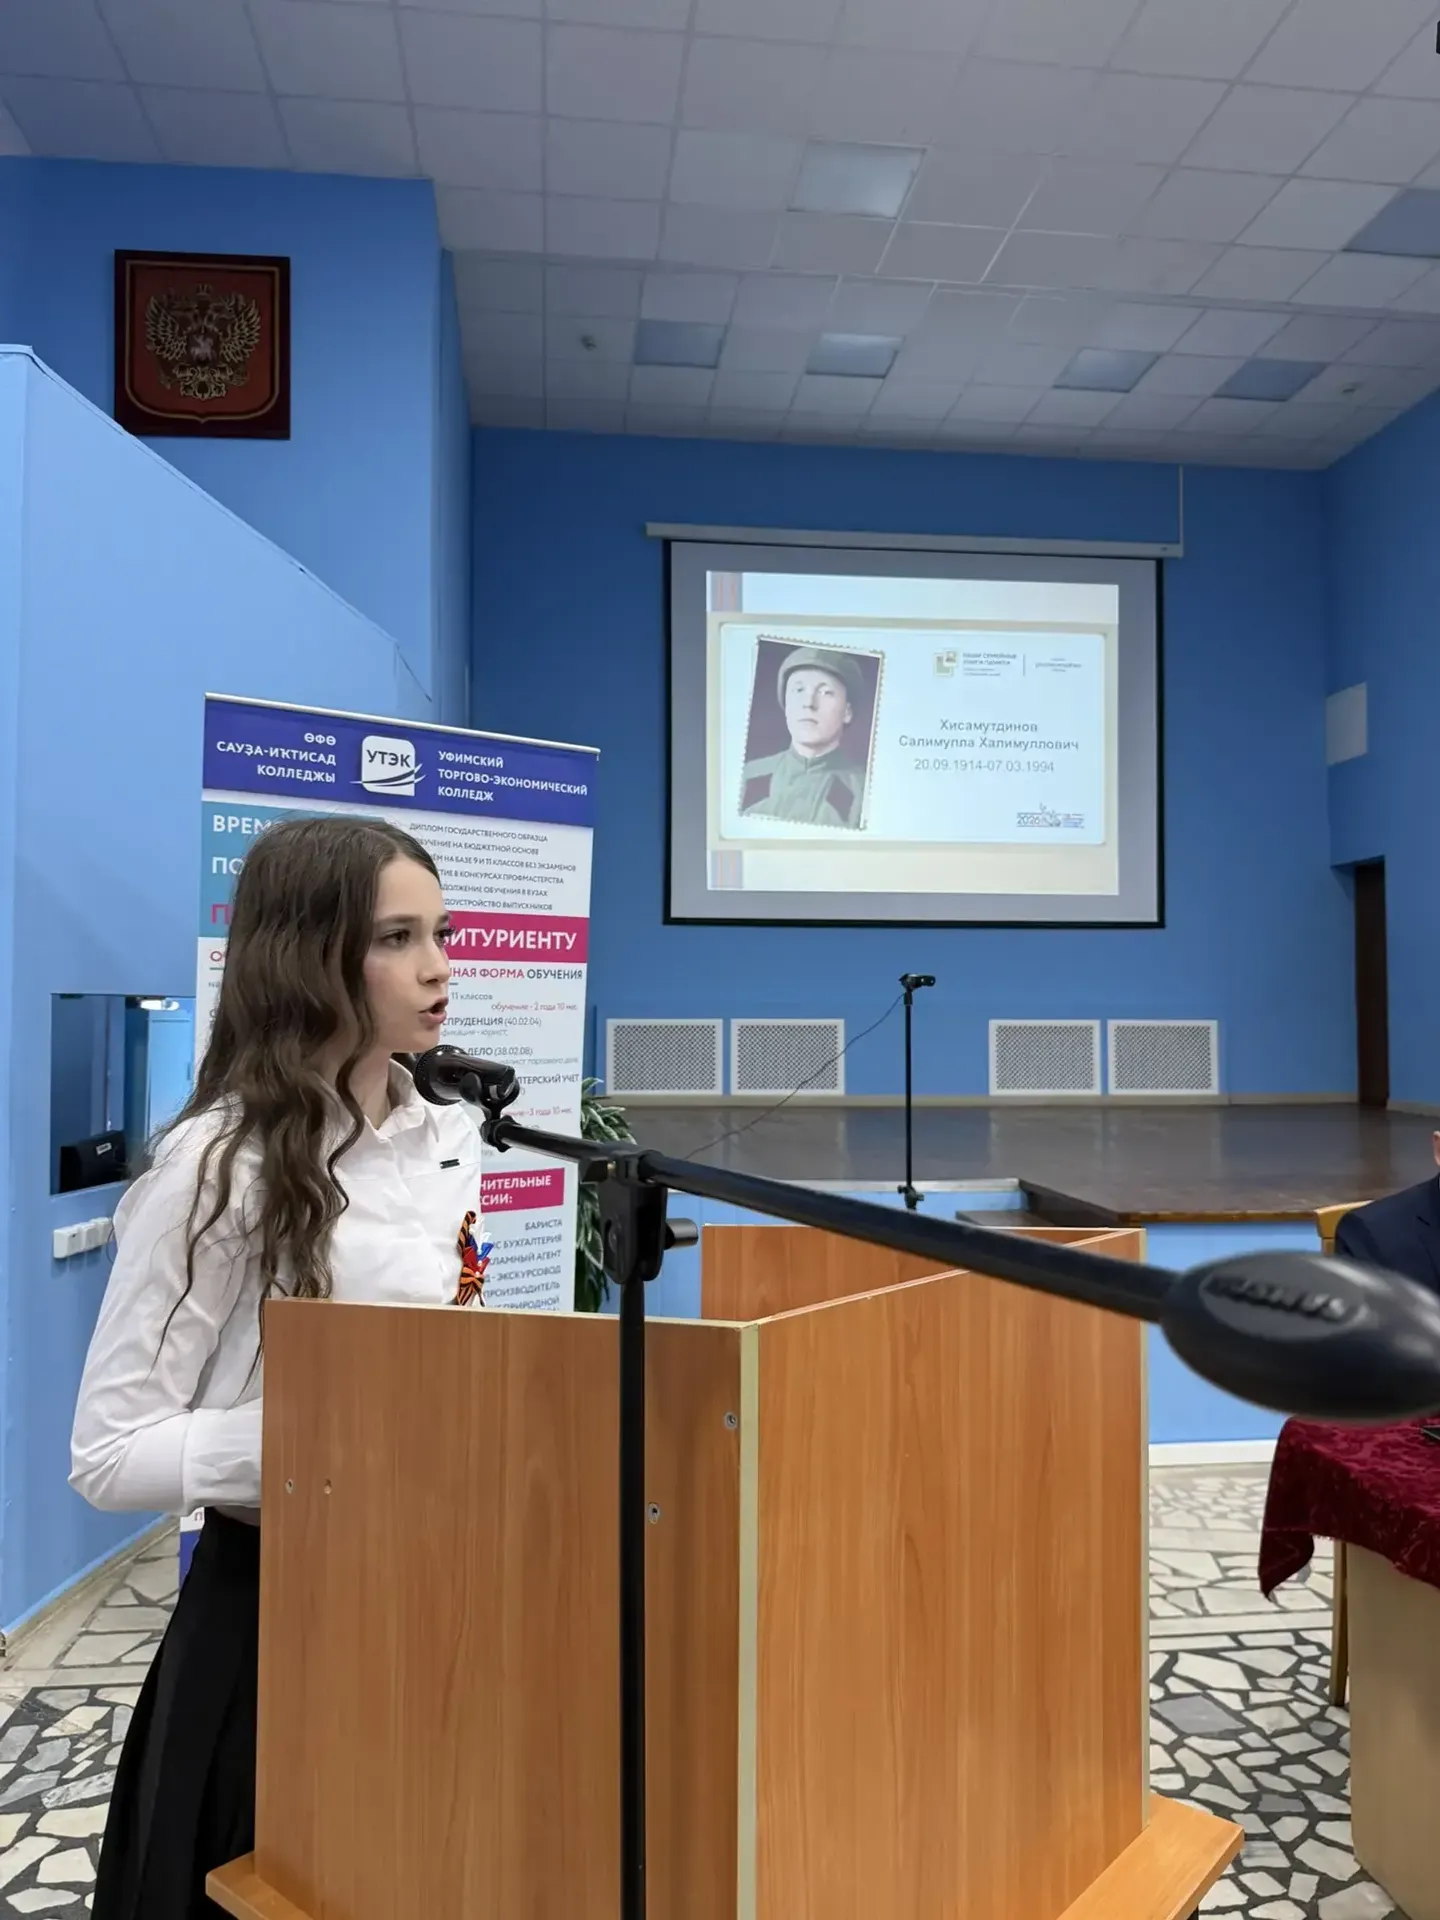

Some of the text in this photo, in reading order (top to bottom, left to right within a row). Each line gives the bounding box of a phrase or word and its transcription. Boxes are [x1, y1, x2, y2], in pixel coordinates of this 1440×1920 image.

[940, 718, 1038, 734] Хисамутдинов
[899, 735, 1079, 751] Салимулла Халимуллович
[366, 749, 411, 769] УТЭК
[438, 750, 504, 769] УФИМСКИЙ
[257, 765, 336, 784] КОЛЛЕДЖЫ
[437, 768, 588, 797] ТОРГОВО-ЭКОНОМИЧЕСКИЙ
[437, 786, 494, 802] КОЛЛЕДЖ
[213, 814, 272, 835] ВРЕМ
[409, 823, 548, 842] ДИПЛОМ ГОСУДАРСТВЕННОГО ОБРАЗЦА
[464, 843, 511, 853] БЮДЖЕТНОЙ
[512, 846, 539, 855] ОСНОВЕ
[456, 856, 472, 864] БАЗЕ
[486, 858, 492, 866] 11
[493, 859, 524, 868] КЛАССОВ
[538, 862, 576, 872] ЭКЗАМЕНОВ
[460, 871, 502, 880] КОНКУРСАХ
[503, 874, 564, 884] ПРОФМАСТЕРСТВА
[441, 884, 482, 894] ДОЛЖЕНИЕ
[484, 886, 521, 895] ОБУЧЕНИЯ
[444, 898, 552, 910] ДОУСТРОЙСТВО ВЫПУСКНИКОВ
[445, 928, 577, 950] ИТУРИЕНТУ
[480, 968, 525, 978] ФОРМА
[526, 969, 583, 980] ОБУЧЕНИЯ
[451, 992, 459, 1000] 11
[467, 1047, 494, 1056] ДЕЛО
[480, 1175, 552, 1190] НИТЕЛЬНЫЕ
[525, 1219, 562, 1230] БАРИСТА
[504, 1234, 562, 1249] БУХГАЛТЕРИЯ
[536, 1249, 562, 1260] АГЕНТ
[496, 1265, 562, 1282] ЭКСКУРСОВОД
[484, 1281, 560, 1298] ПРОИЗВОДИТЕЛЬ
